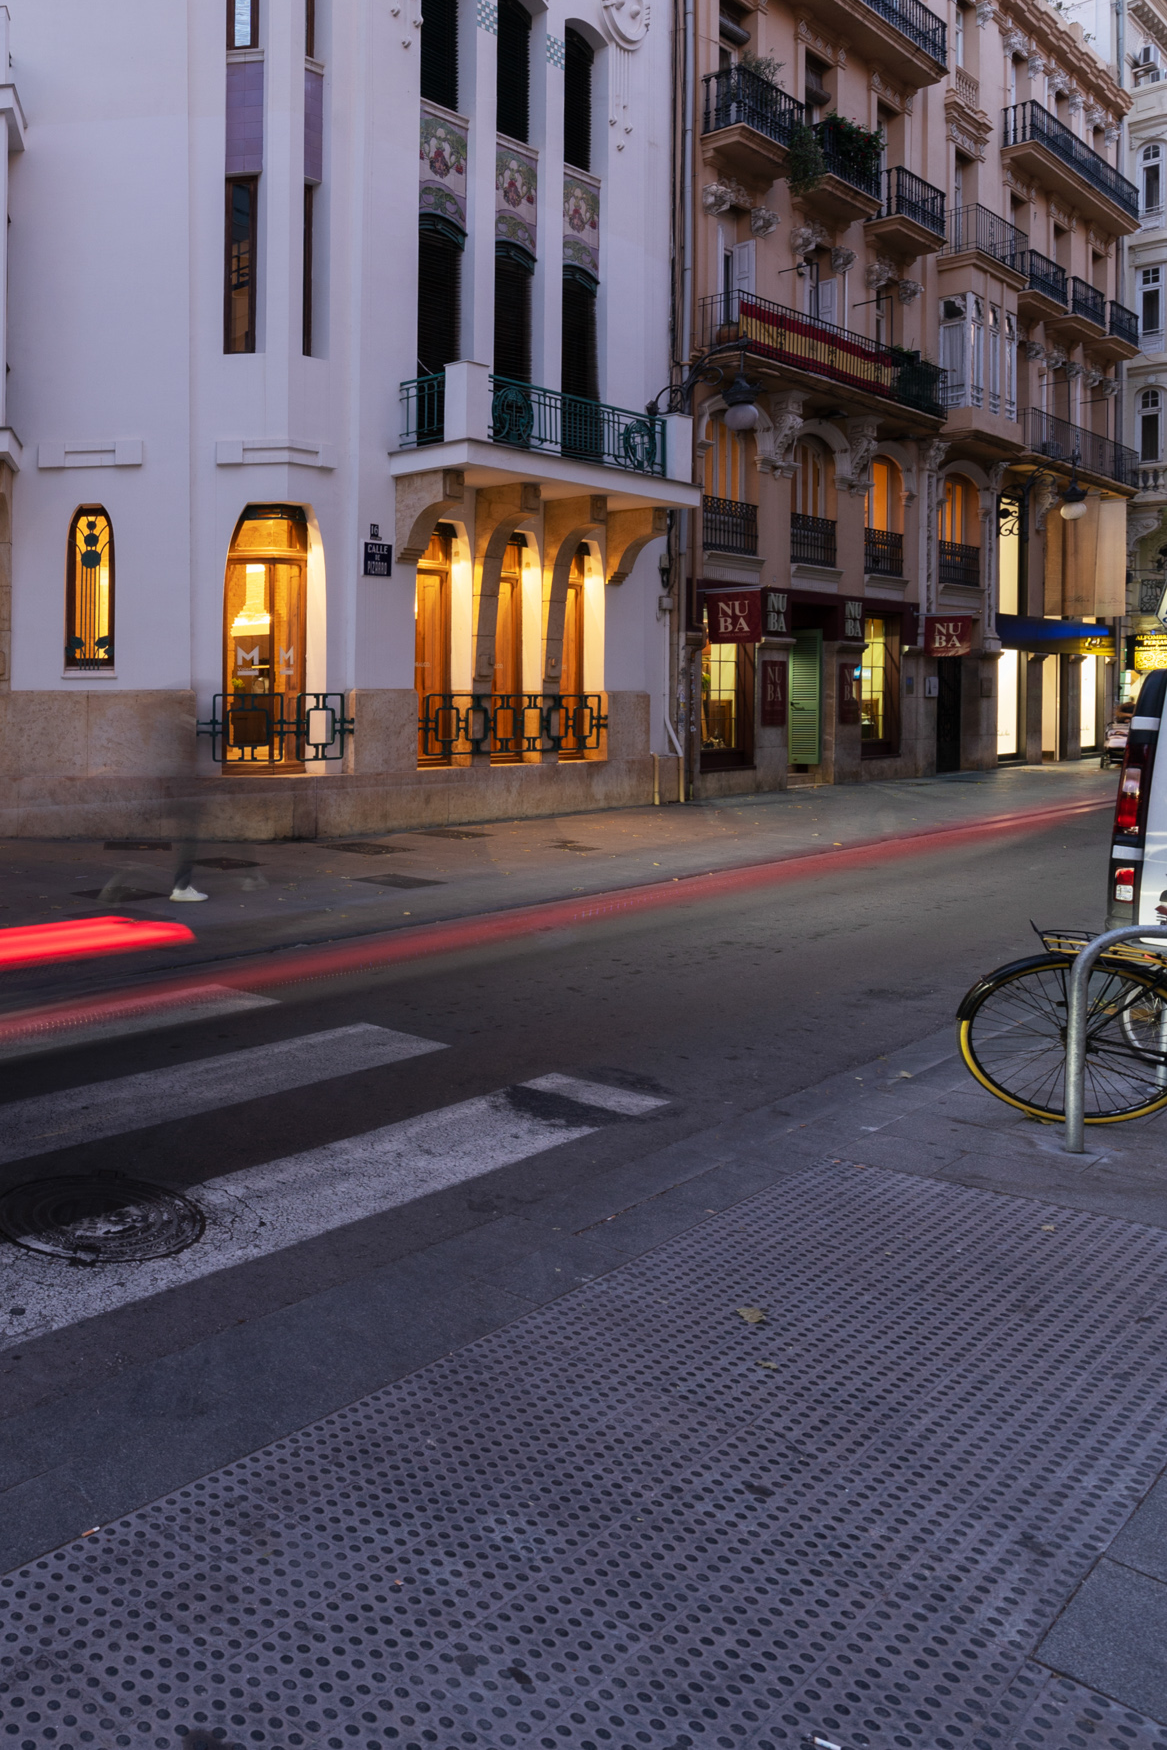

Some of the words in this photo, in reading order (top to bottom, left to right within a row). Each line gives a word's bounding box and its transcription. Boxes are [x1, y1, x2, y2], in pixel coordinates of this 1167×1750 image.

[367, 544, 389, 555] CALLE
[718, 600, 749, 617] NU
[766, 592, 788, 613] NU
[844, 601, 863, 620] NU
[718, 616, 750, 633] BA
[766, 612, 787, 632] BA
[845, 620, 863, 637] BA
[934, 622, 963, 635] NU
[933, 635, 962, 648] BA
[237, 645, 259, 666] M
[279, 645, 294, 665] M
[767, 666, 782, 684] NU
[767, 684, 782, 701] BA
